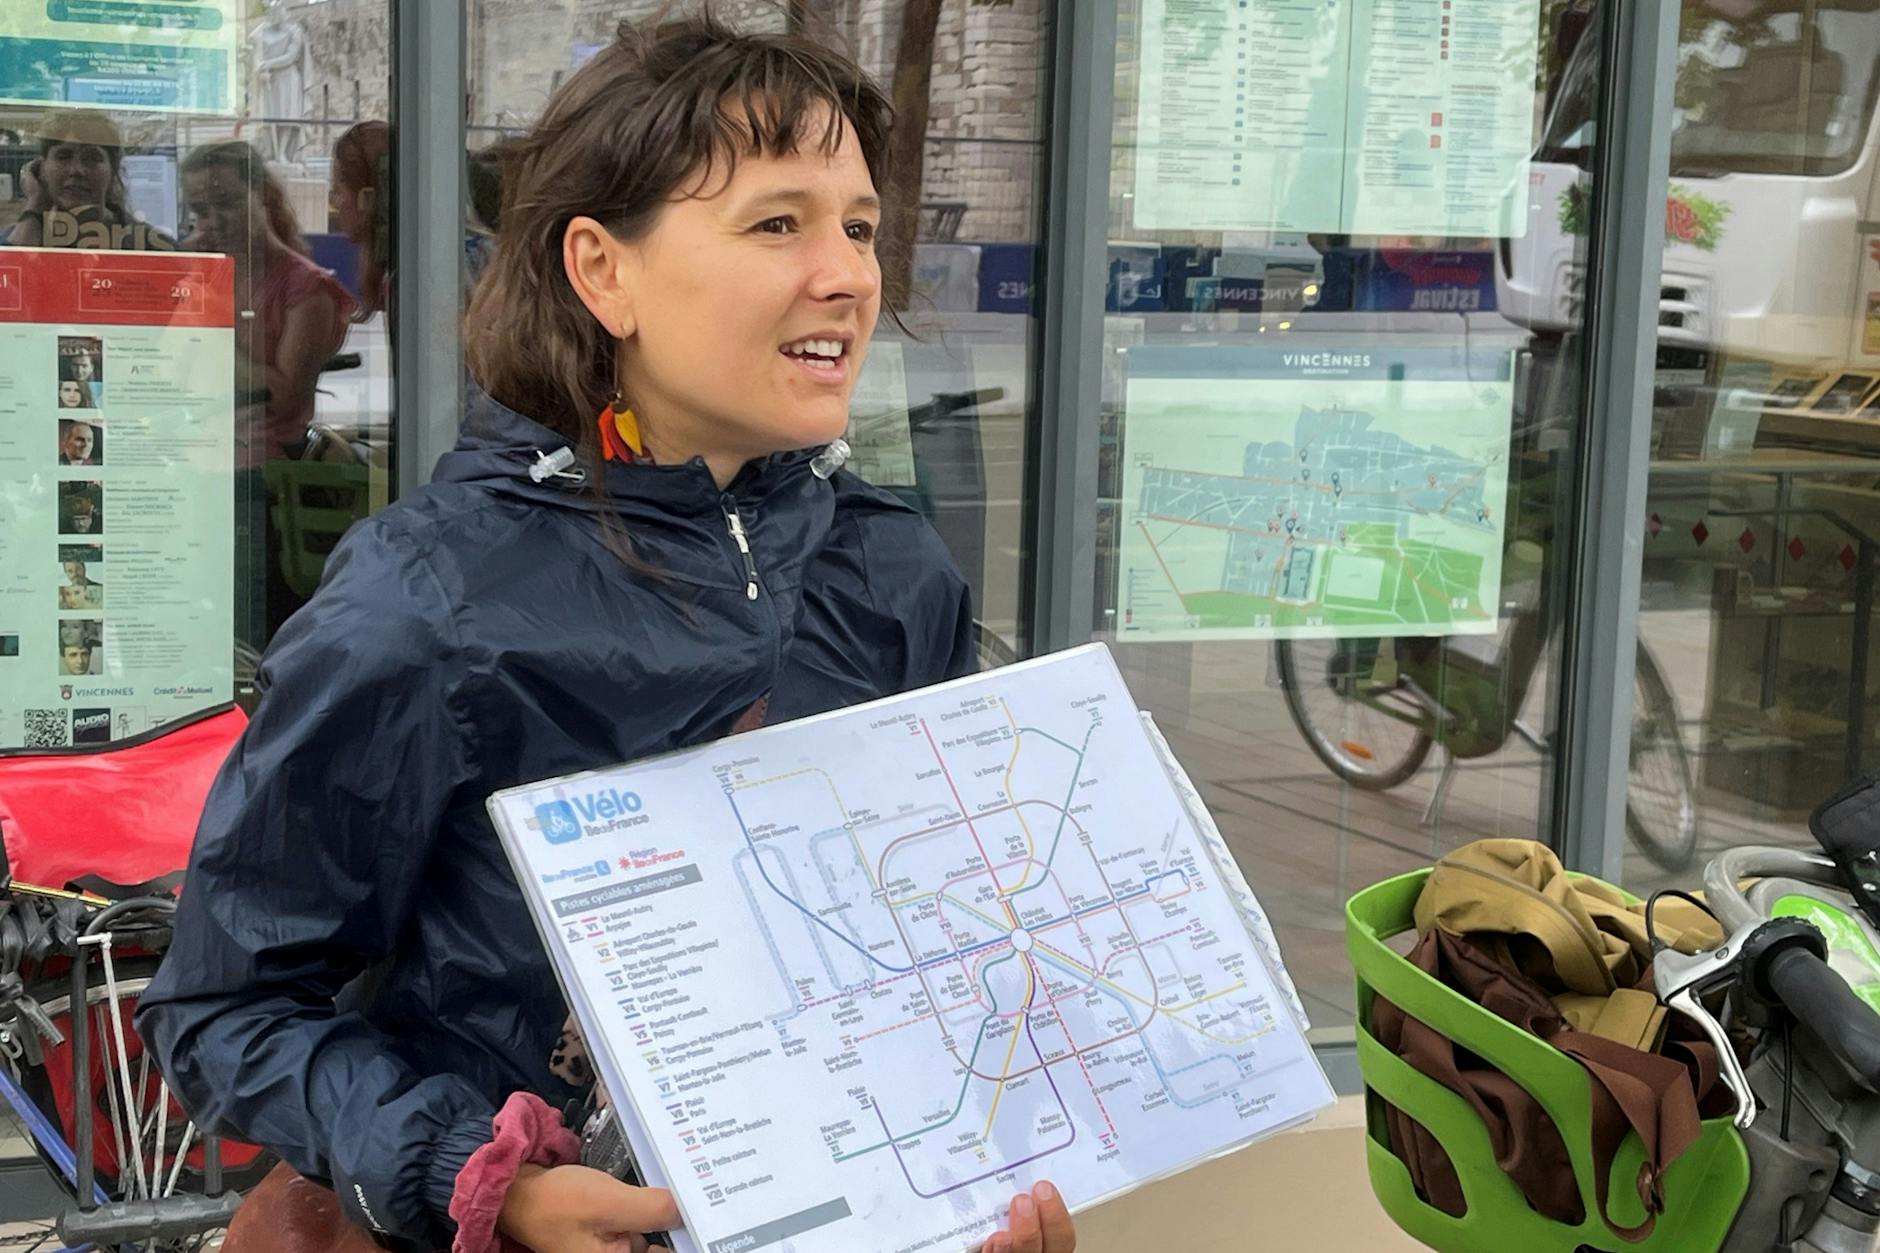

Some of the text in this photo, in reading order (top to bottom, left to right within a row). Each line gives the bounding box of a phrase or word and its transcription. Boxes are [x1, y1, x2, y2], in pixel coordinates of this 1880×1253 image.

[1283, 353, 1371, 367] VINCENNES
[75, 687, 134, 698] VINCENNES
[153, 686, 213, 696] Crédit Mutuel
[74, 713, 109, 727] AUDIO
[571, 788, 642, 822] Vélo
[560, 873, 685, 911] Pistes cyclables aménagées
[586, 923, 598, 931] V1
[597, 948, 610, 957] V2
[622, 963, 638, 971] Parc
[638, 959, 651, 967] des
[610, 976, 623, 985] V3
[623, 1004, 636, 1013] V4
[634, 1030, 647, 1039] V5
[647, 1056, 660, 1066] V6
[658, 1082, 670, 1092] V7
[671, 1109, 684, 1118] V8
[683, 1136, 696, 1145] V9
[694, 1162, 711, 1173] V10
[706, 1189, 723, 1200] V20
